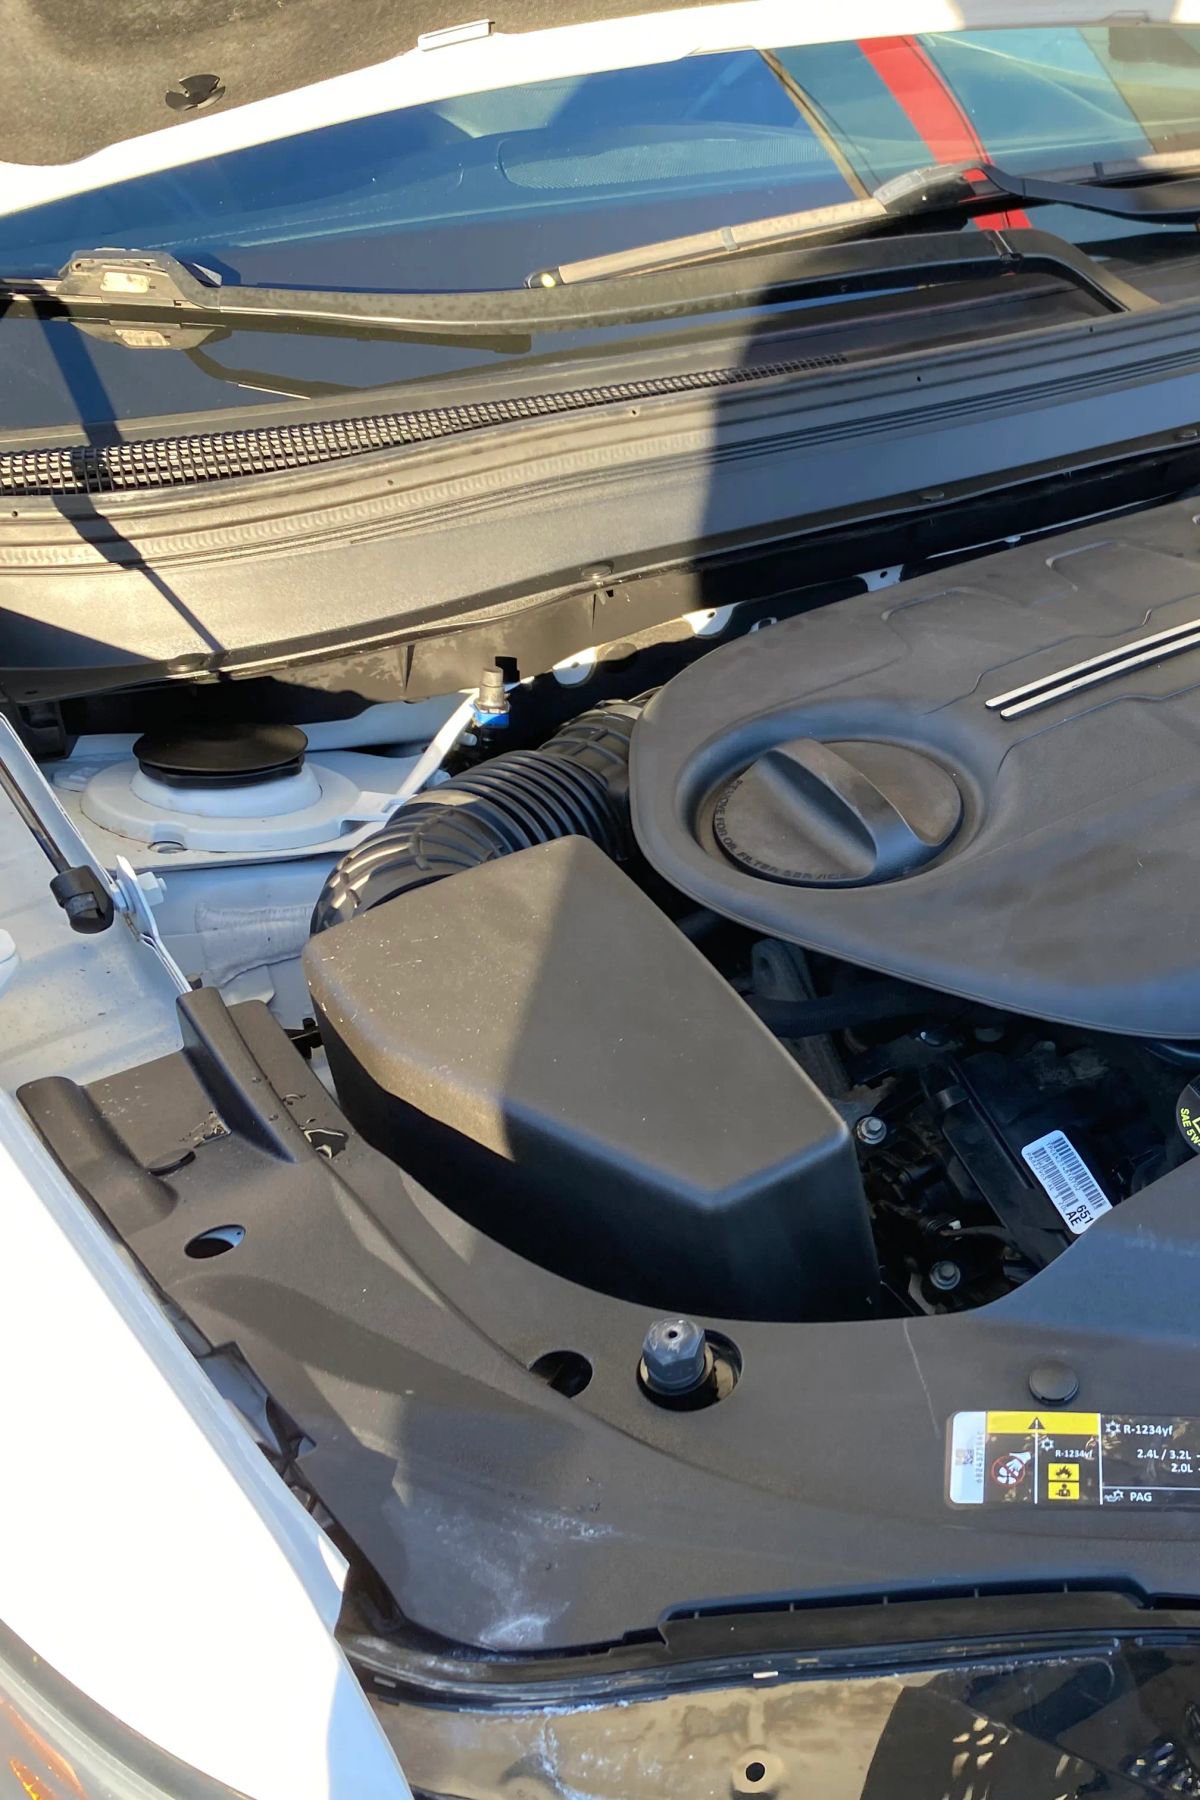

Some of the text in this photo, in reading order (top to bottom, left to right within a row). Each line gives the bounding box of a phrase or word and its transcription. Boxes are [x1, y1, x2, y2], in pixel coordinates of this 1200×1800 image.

[1180, 1108, 1192, 1128] SAE
[1065, 1209, 1081, 1227] AE
[1075, 1204, 1094, 1225] 651
[1123, 1424, 1173, 1437] R-1234yf
[1055, 1449, 1093, 1459] R-1234yf
[1136, 1448, 1159, 1459] 2.4L
[1169, 1450, 1191, 1460] 3.2L
[1170, 1462, 1193, 1473] 2.0L
[1129, 1492, 1153, 1502] PAG
